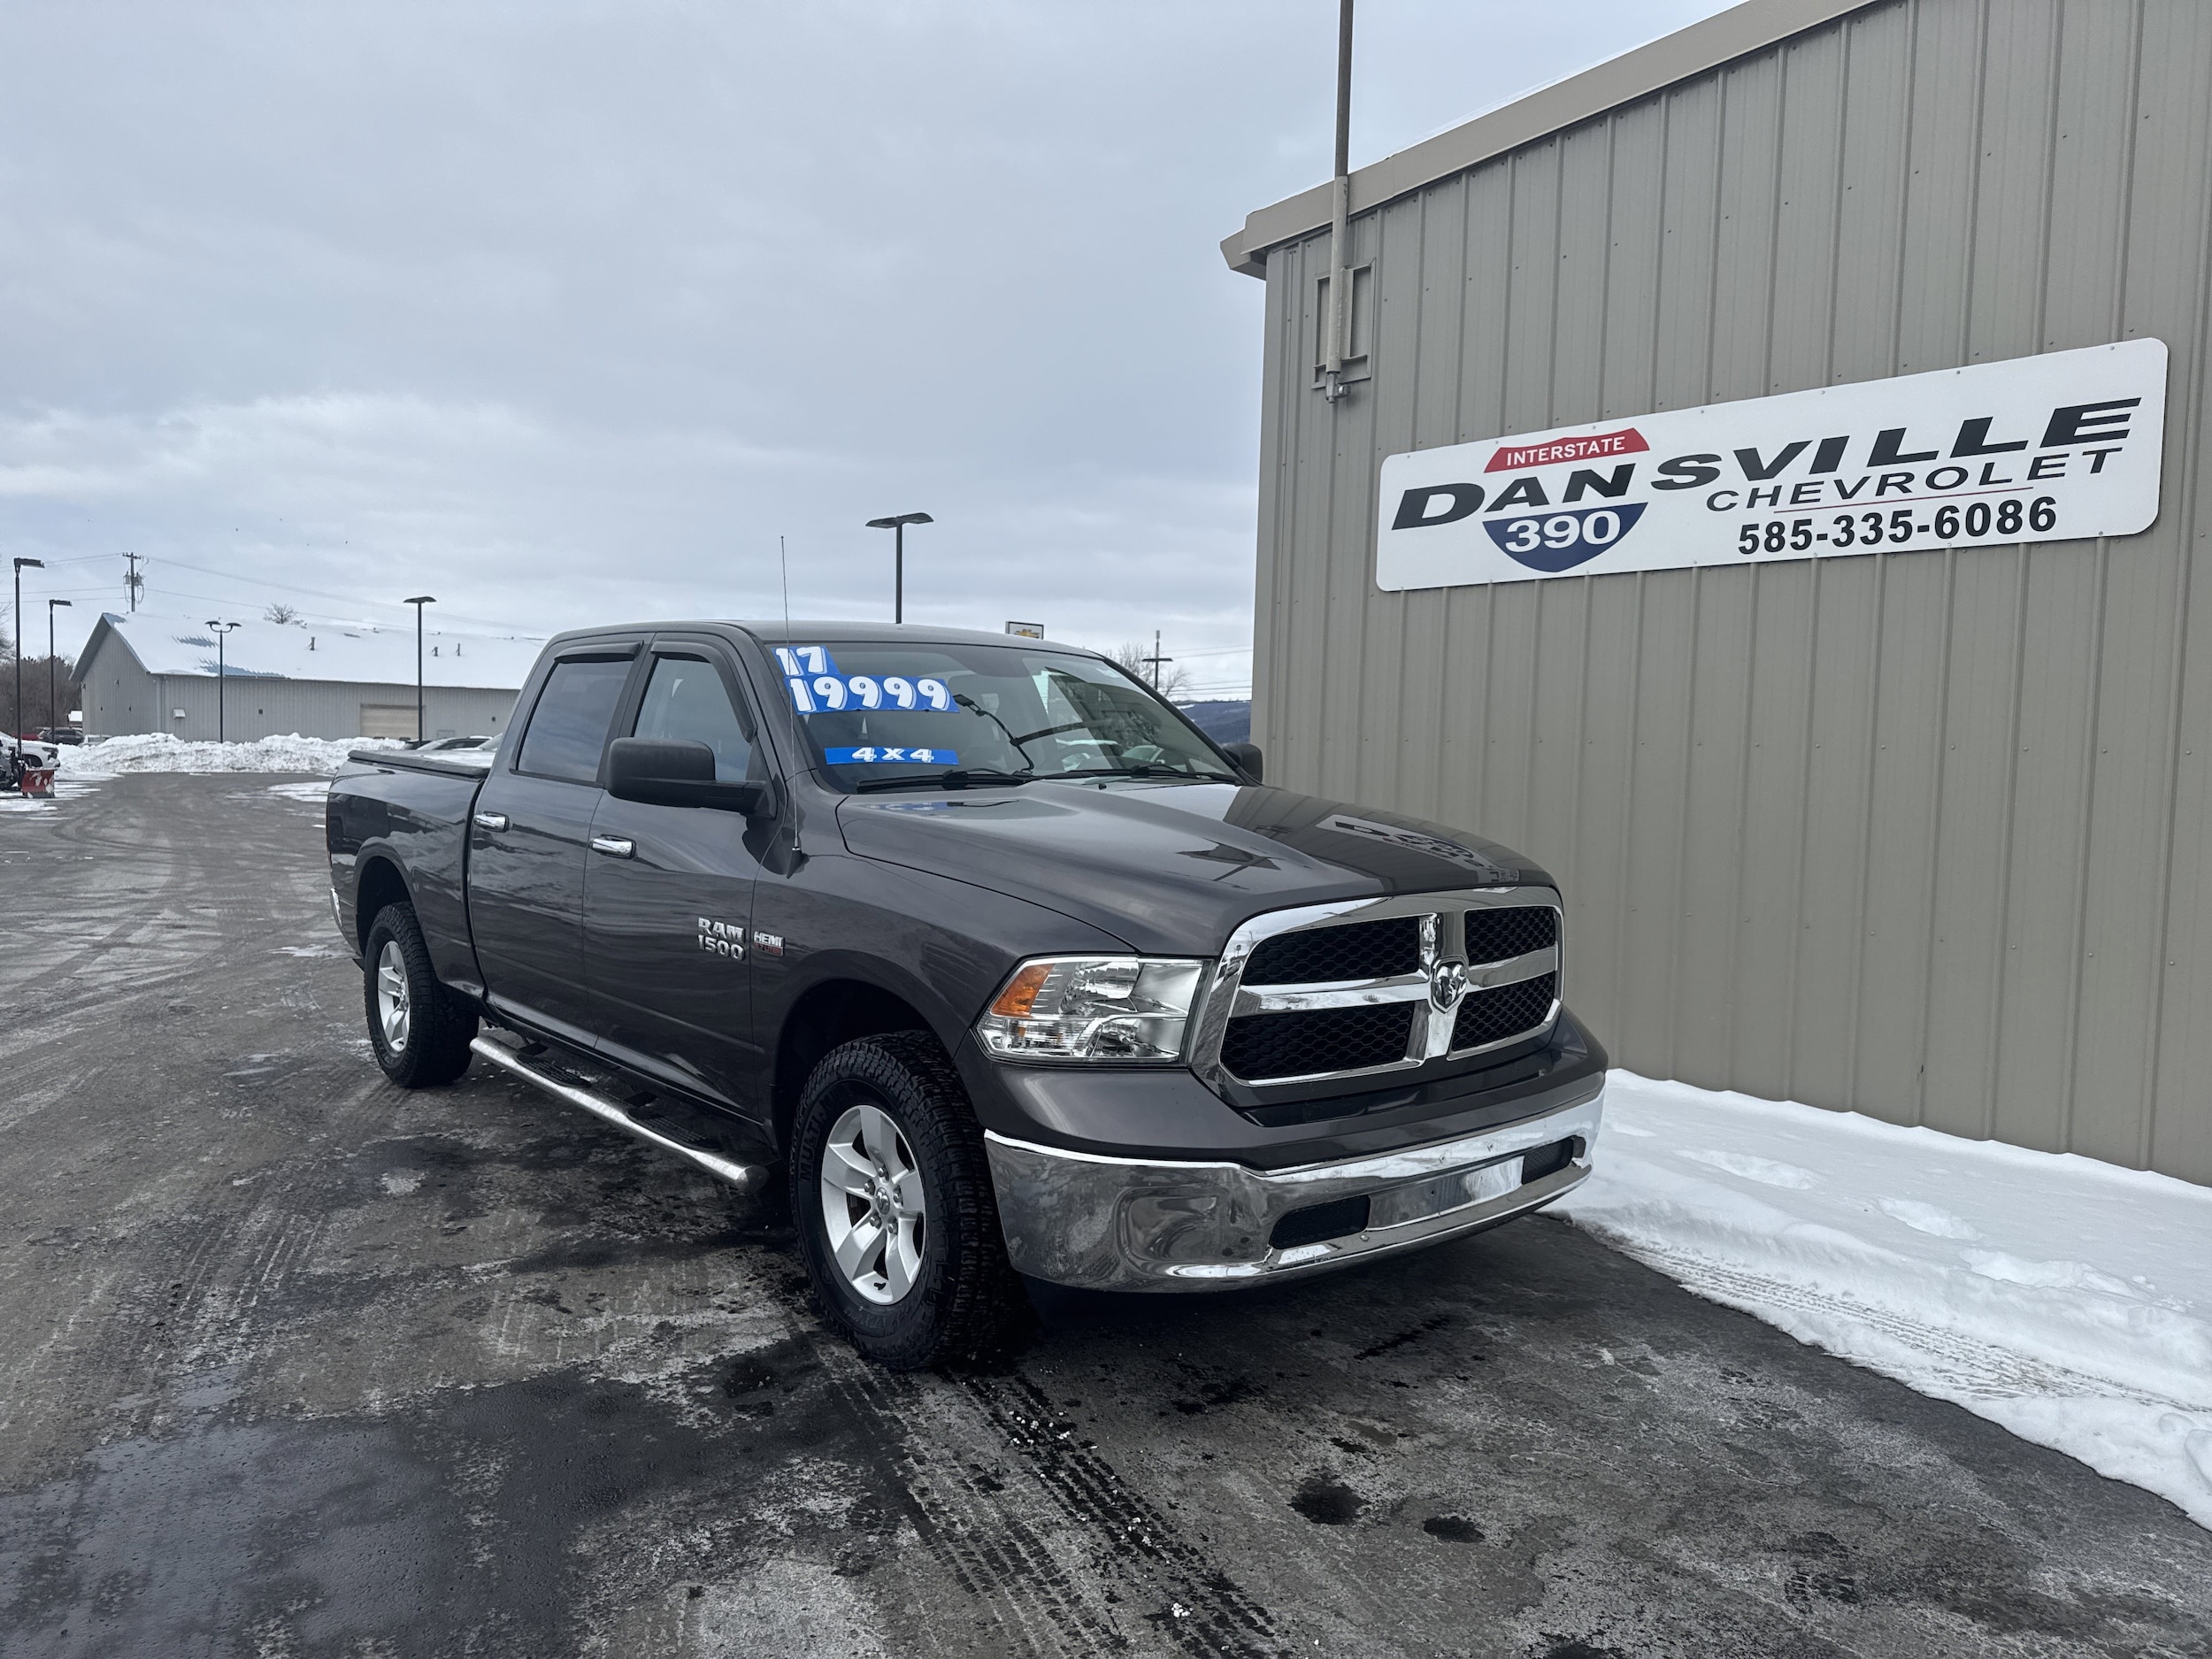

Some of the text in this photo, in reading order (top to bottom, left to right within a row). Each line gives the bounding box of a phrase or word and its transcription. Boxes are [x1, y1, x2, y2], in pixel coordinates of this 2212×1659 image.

[1391, 397, 2142, 530] DANSVILLE
[1507, 436, 1626, 465] INTERSTATE
[1706, 447, 2123, 512] CHEVROLET
[1504, 512, 1622, 555] 390
[1738, 495, 2057, 555] 585-335-6086
[775, 646, 828, 676] 17
[790, 676, 950, 712] 19999
[698, 918, 743, 941] RAM
[754, 931, 783, 947] HEMI
[698, 934, 745, 962] 1500
